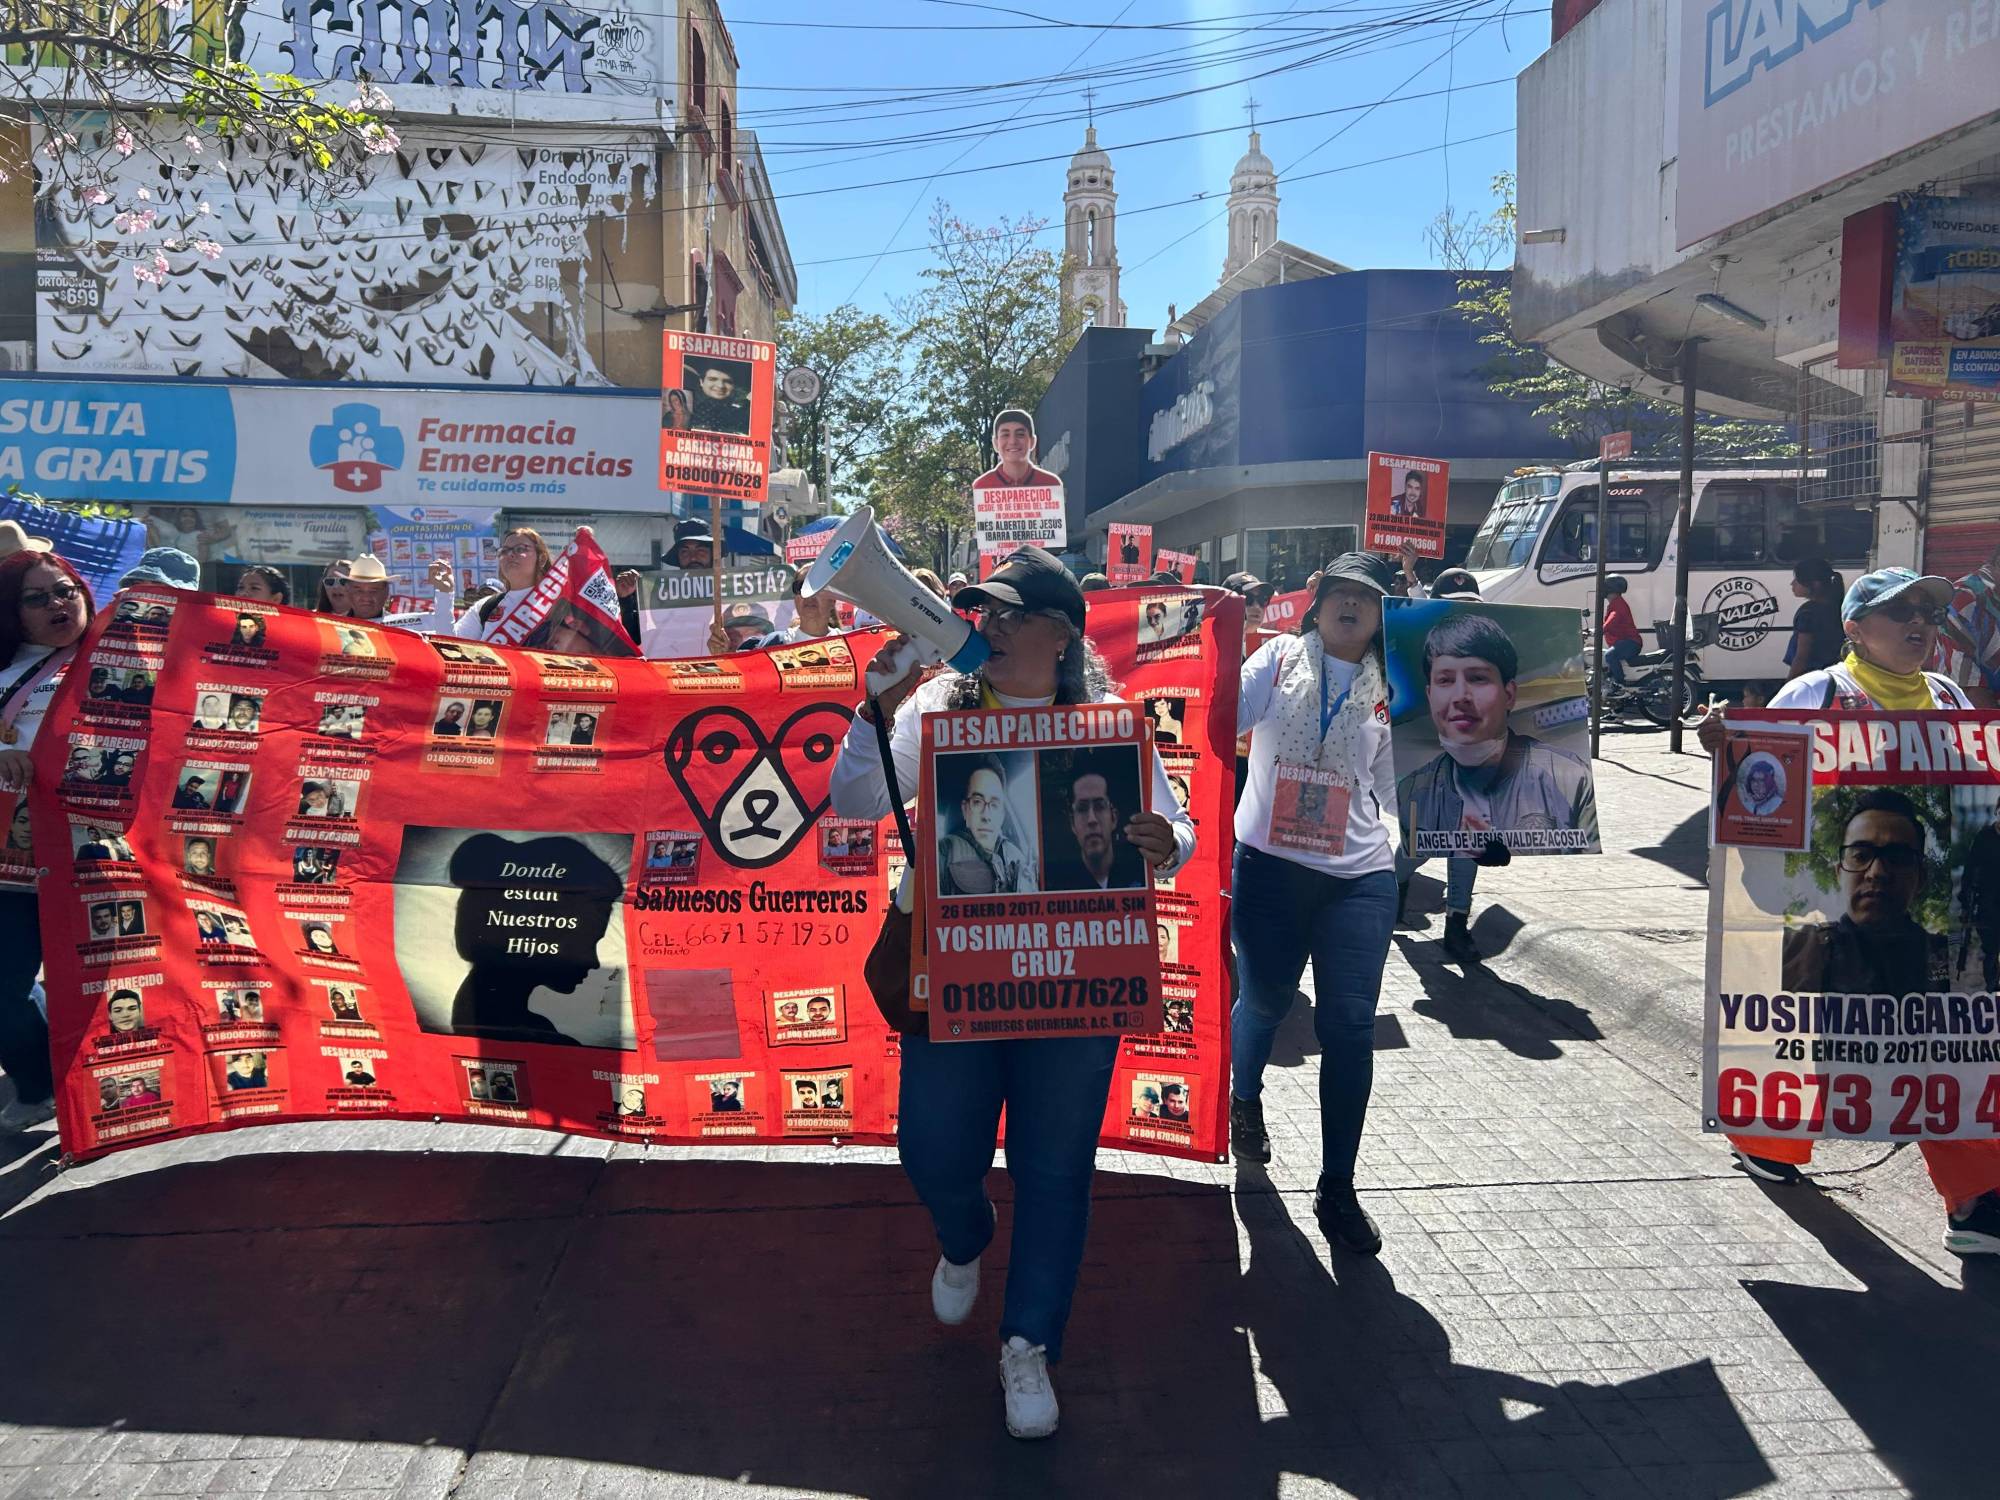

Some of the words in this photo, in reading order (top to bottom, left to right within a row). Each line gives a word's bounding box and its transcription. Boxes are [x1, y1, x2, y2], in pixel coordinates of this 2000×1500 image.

[1726, 48, 1897, 168] PRESTAMOS
[1909, 26, 1932, 78] Y
[669, 334, 770, 362] DESAPARECIDO
[0, 399, 147, 436] SULTA
[417, 417, 577, 446] Farmacia
[676, 439, 720, 457] CARLOS
[721, 444, 754, 460] OMAR
[34, 447, 210, 484] GRATIS
[417, 447, 634, 481] Emergencias
[716, 457, 763, 475] ESPARZA
[1379, 456, 1441, 473] DESAPARECIDO
[416, 477, 437, 492] Te
[440, 477, 526, 493] cuidamos
[529, 479, 567, 495] más
[665, 464, 763, 490] 01800077628
[983, 488, 1052, 504] DESAPARECIDO
[1607, 487, 1645, 497] OXER
[658, 572, 728, 601] ¿DÓNDE
[733, 566, 788, 597] ESTÁ?
[1714, 577, 1754, 599] PURO
[1717, 597, 1777, 624] NALOA
[90, 651, 165, 671] DESAPARECIDO
[196, 681, 270, 697] DESAPARECIDO
[784, 673, 854, 685] 018006703600
[314, 691, 381, 707] DESAPARECIDO
[933, 708, 1135, 748] DESAPARECIDO
[67, 731, 148, 752] DESAPARECIDO
[426, 753, 496, 766] 018006703600
[298, 764, 371, 781] DESAPARECIDO
[1417, 833, 1451, 850] ANGEL
[1455, 833, 1468, 848] DE
[1506, 831, 1546, 848] VALDEZ
[1549, 830, 1588, 848] ACOSTA
[499, 861, 568, 880] Donde
[633, 880, 743, 914] Sabuesos
[750, 880, 868, 914] Guerreras
[941, 903, 960, 919] 26
[962, 901, 1006, 919] ENERO
[1122, 896, 1147, 913] SIN
[486, 909, 580, 930] Nuestros
[756, 921, 785, 947] 57
[791, 921, 850, 947] 1930
[935, 922, 1049, 954] YOSIMAR
[1055, 917, 1150, 949] GARCÍA
[505, 937, 561, 959] Hijos
[1010, 948, 1077, 980] CRUZ
[81, 972, 165, 996] DESAPARECIDO
[201, 980, 273, 990] DESAPARECIDO
[941, 975, 1149, 1016] 01800077628
[1720, 992, 1896, 1036] YOSIMAR
[1903, 994, 2000, 1038] GARC
[319, 1045, 388, 1060] DESAPARECIDO
[1775, 1038, 1806, 1061] 26
[1811, 1039, 1879, 1064] ENERO
[1883, 1040, 1927, 1064] 2017
[91, 1058, 165, 1078] DESAPARECIDO
[592, 1069, 660, 1086] DESAPARECIDO
[784, 1071, 849, 1082] DESAPARECIDO
[1717, 1067, 1873, 1136] 6673
[1889, 1074, 1961, 1136] 29
